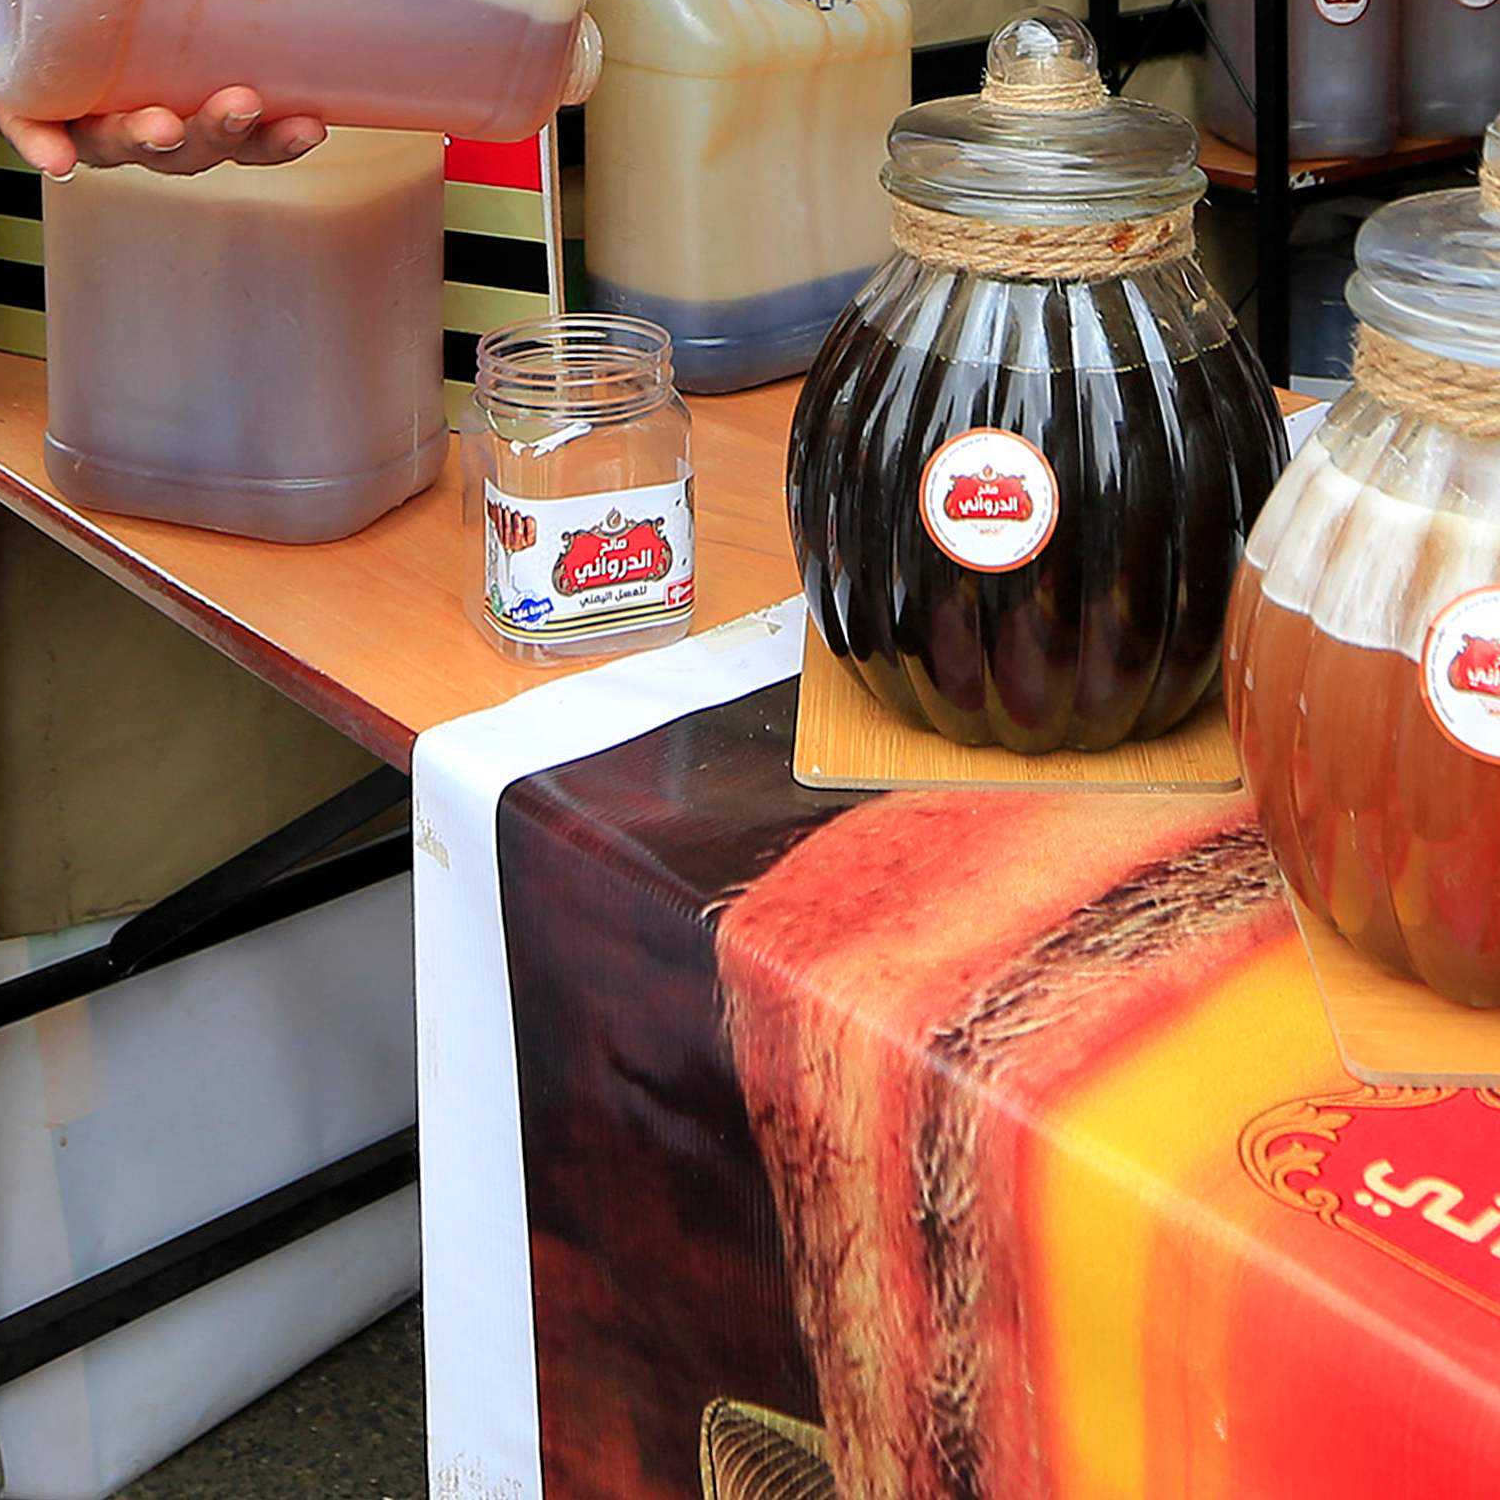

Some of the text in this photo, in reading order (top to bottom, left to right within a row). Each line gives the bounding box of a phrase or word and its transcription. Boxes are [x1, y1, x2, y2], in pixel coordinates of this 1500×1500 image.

[958, 496, 1018, 516] الدرواني
[599, 537, 628, 554] صالح
[574, 549, 653, 584] الدرواني
